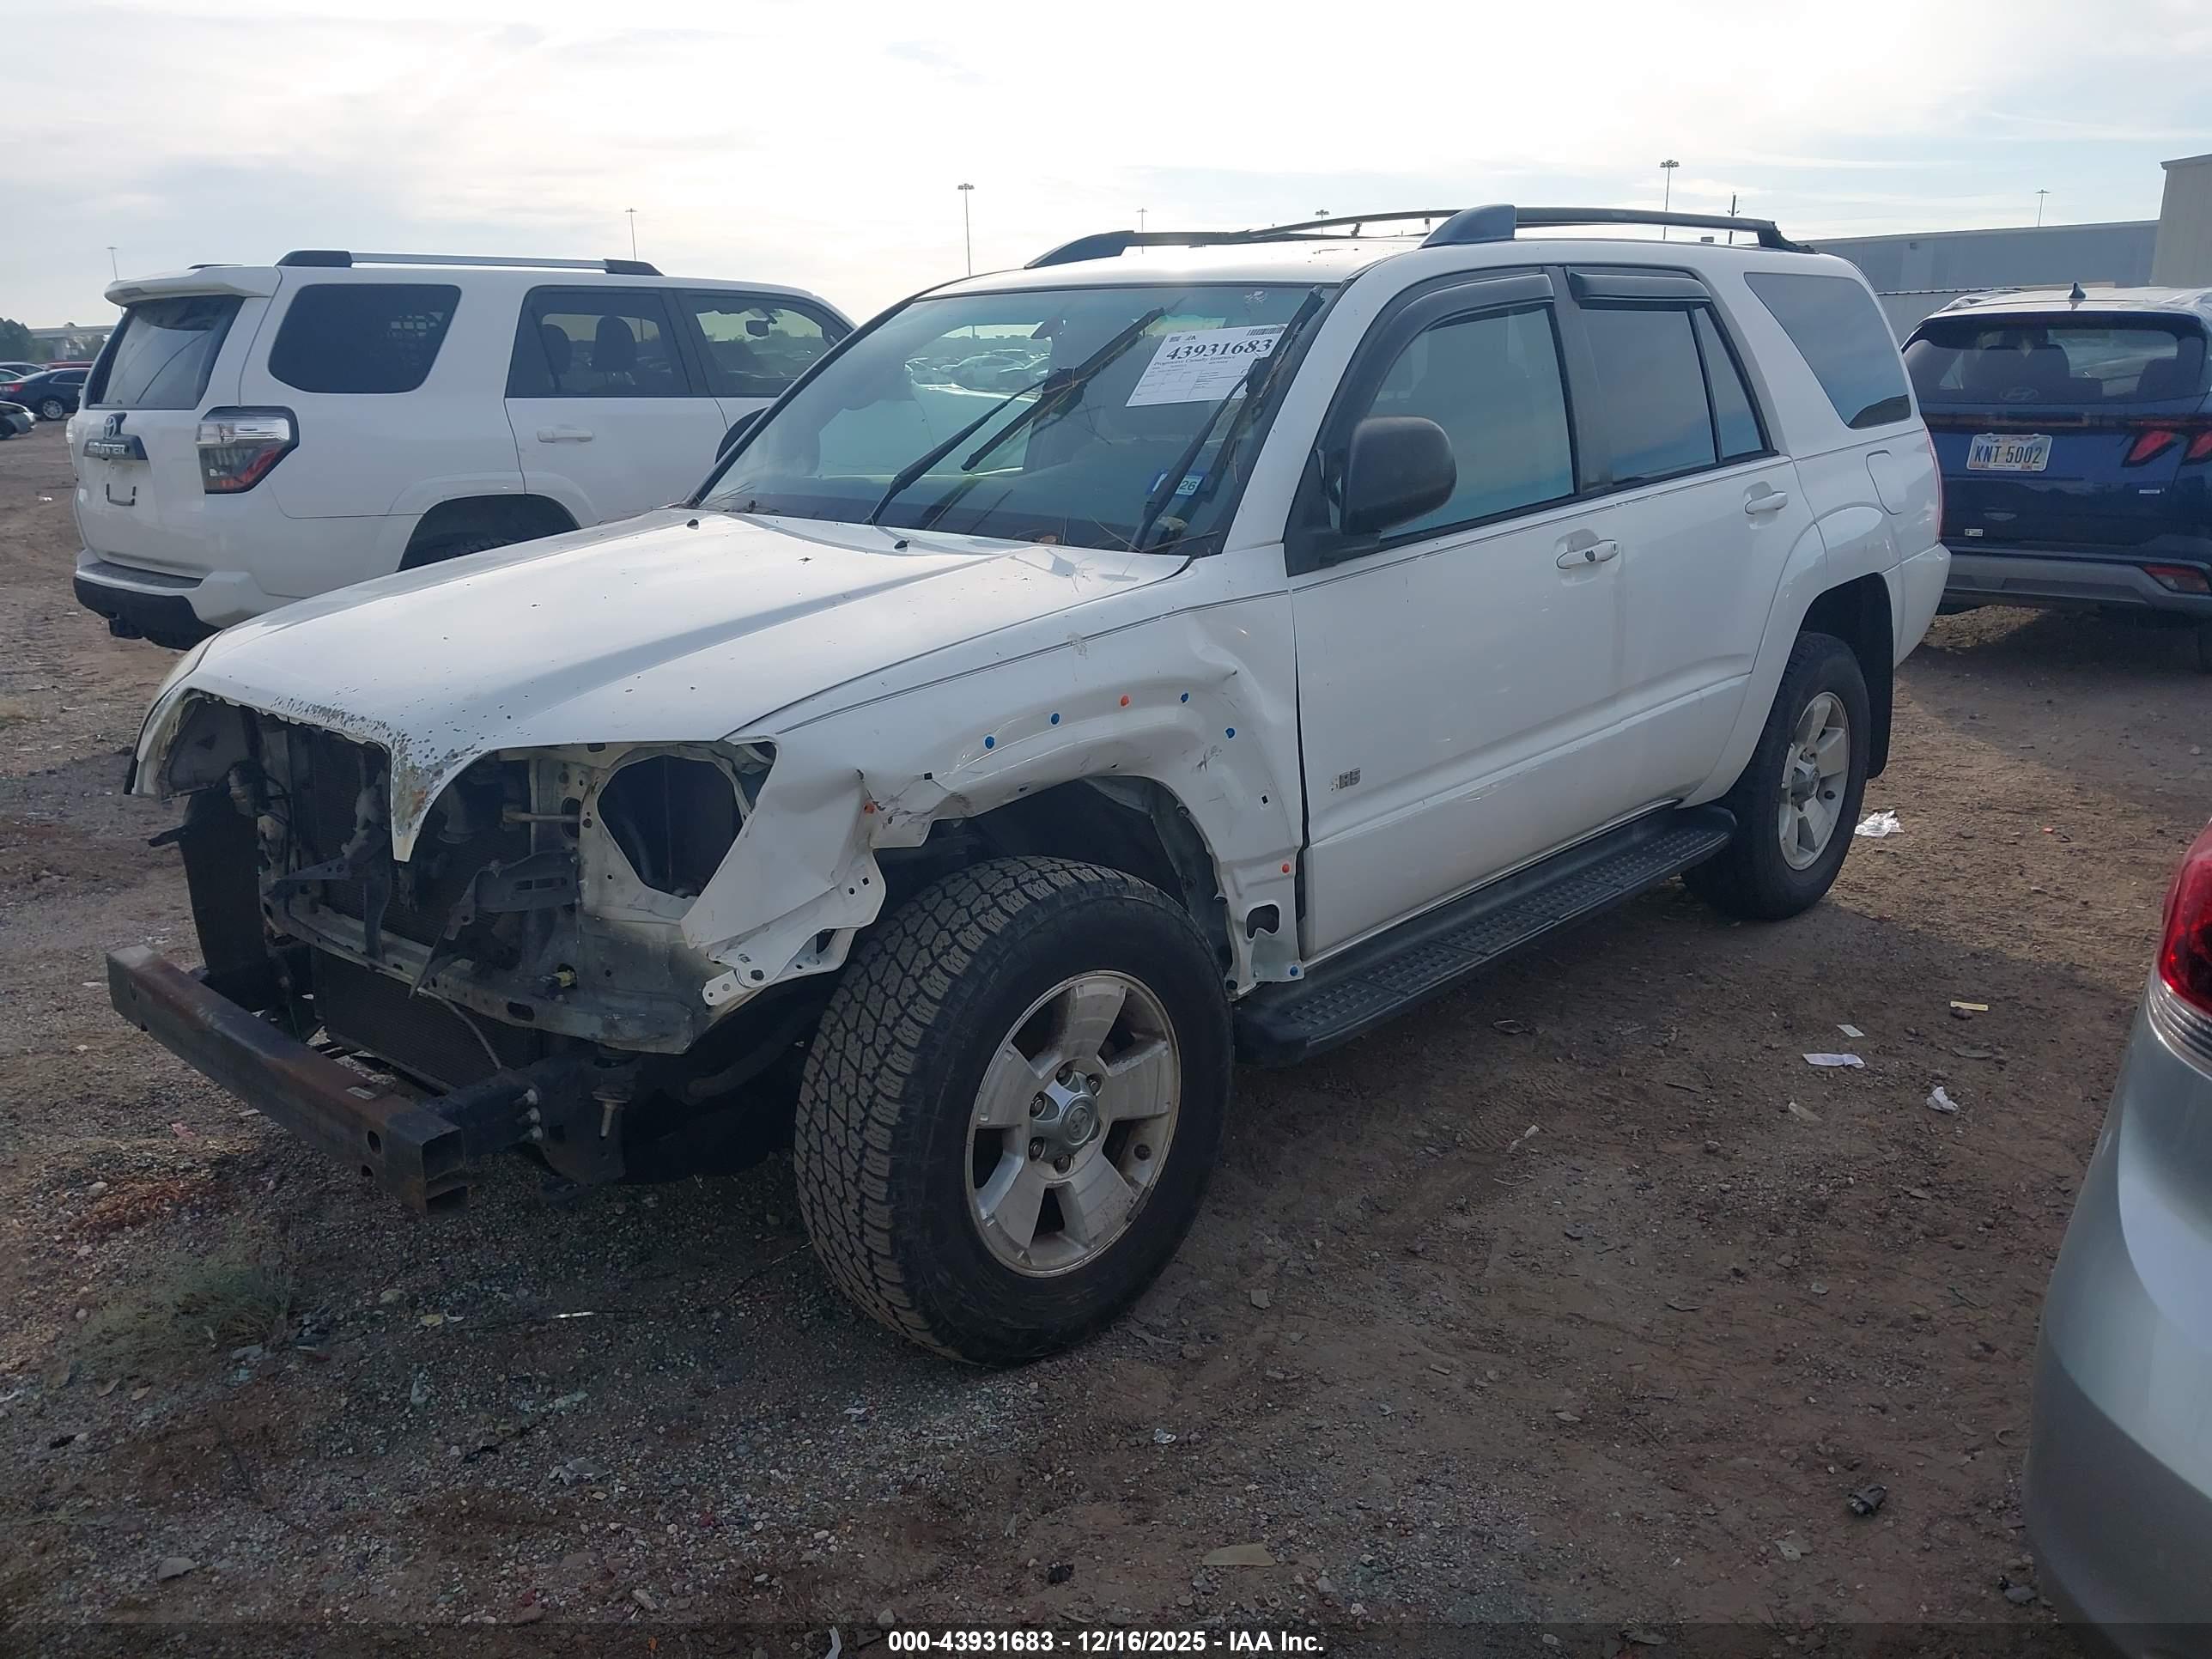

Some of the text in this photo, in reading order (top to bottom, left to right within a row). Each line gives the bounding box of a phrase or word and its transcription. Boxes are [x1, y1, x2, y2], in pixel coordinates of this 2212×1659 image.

[1166, 339, 1273, 360] 43931683
[1975, 446, 2042, 464] KNT 5002
[1180, 481, 1197, 490] 26
